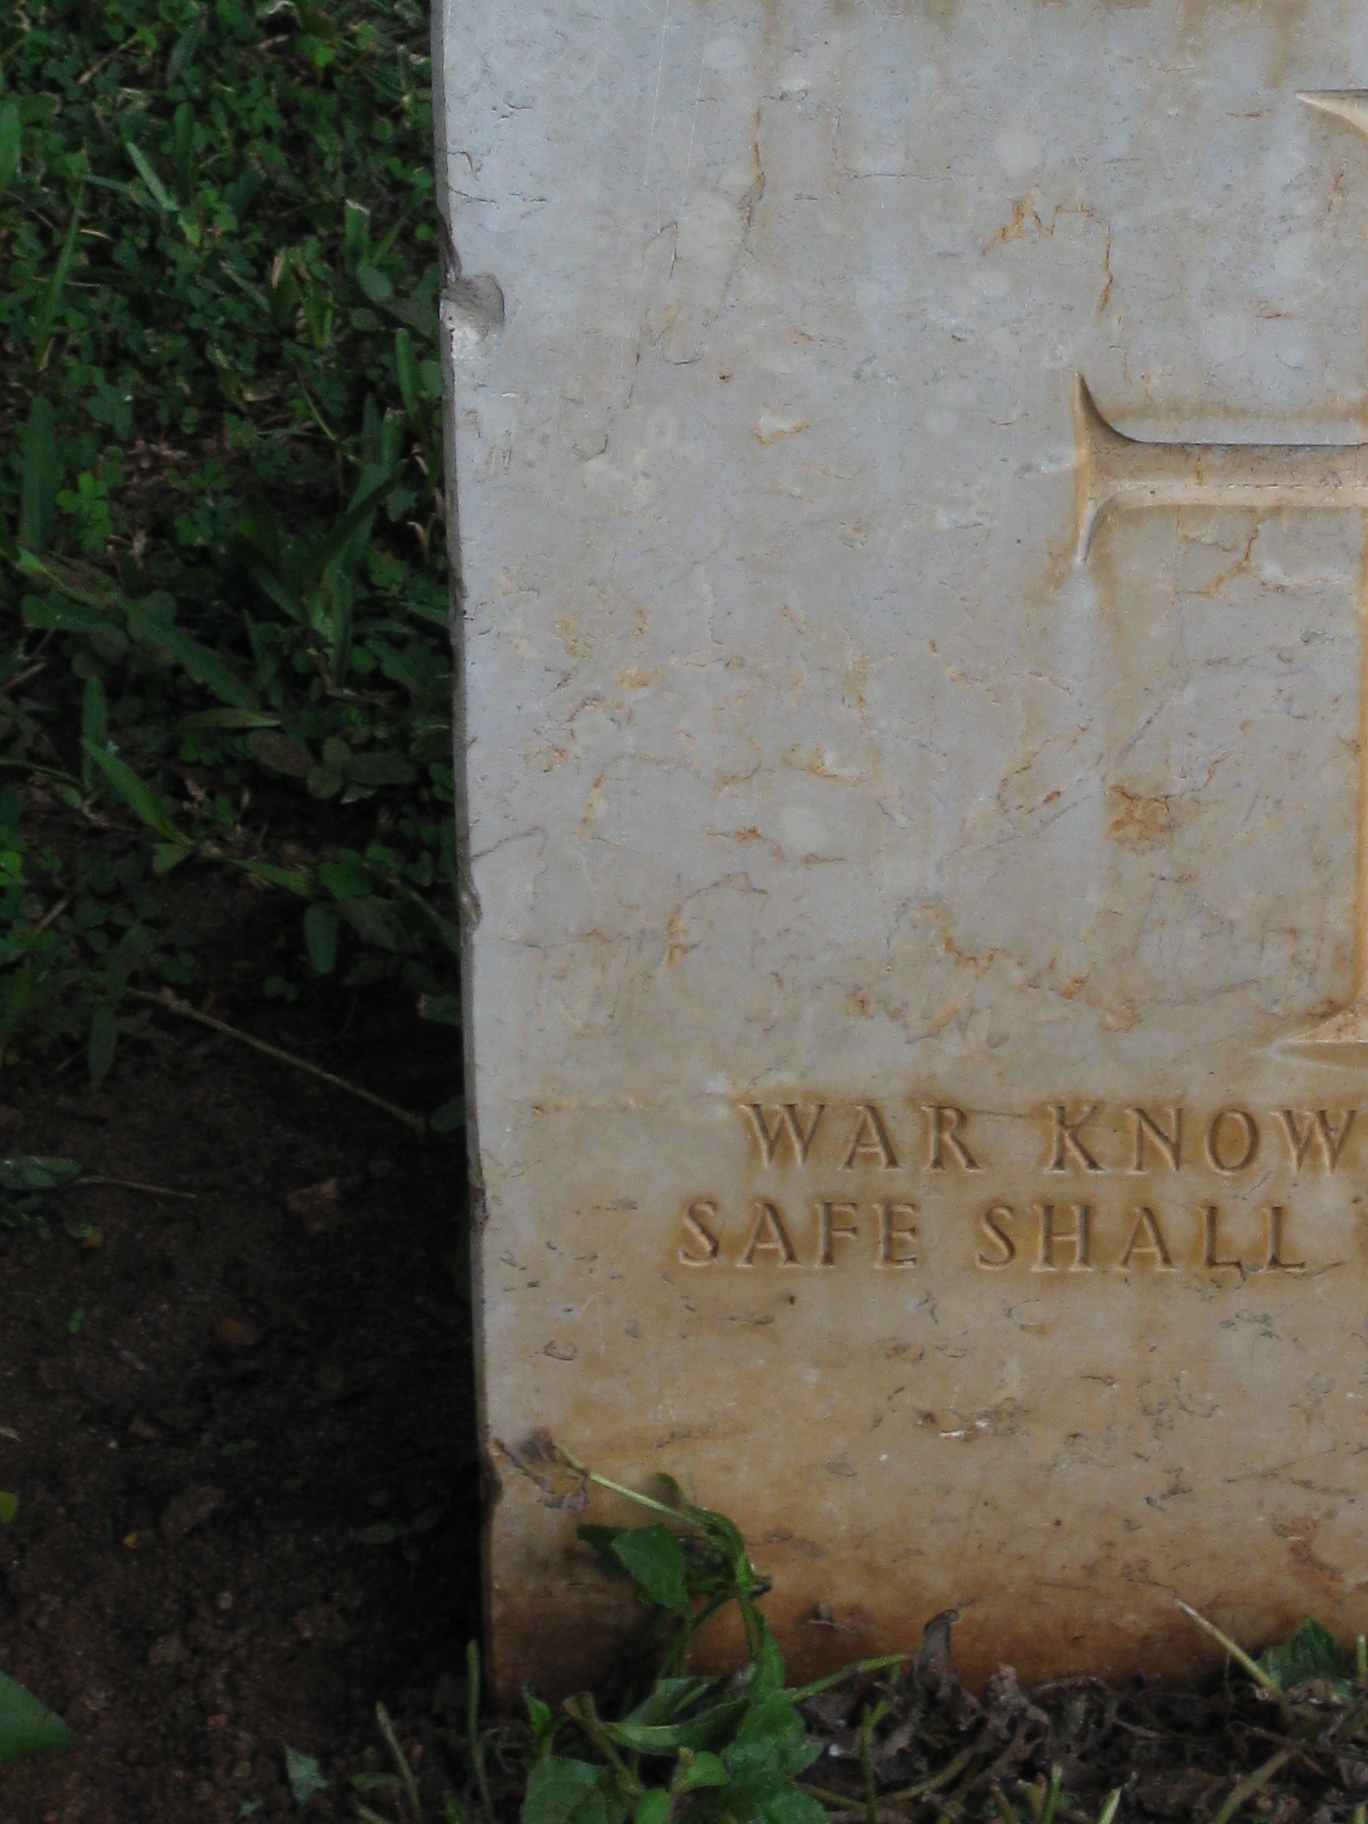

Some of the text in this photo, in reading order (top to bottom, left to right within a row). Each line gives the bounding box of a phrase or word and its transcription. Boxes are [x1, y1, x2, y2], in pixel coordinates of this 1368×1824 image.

[738, 1102, 982, 1172] WAR
[678, 1200, 918, 1269] SAFE
[975, 1203, 1306, 1272] SHALL
